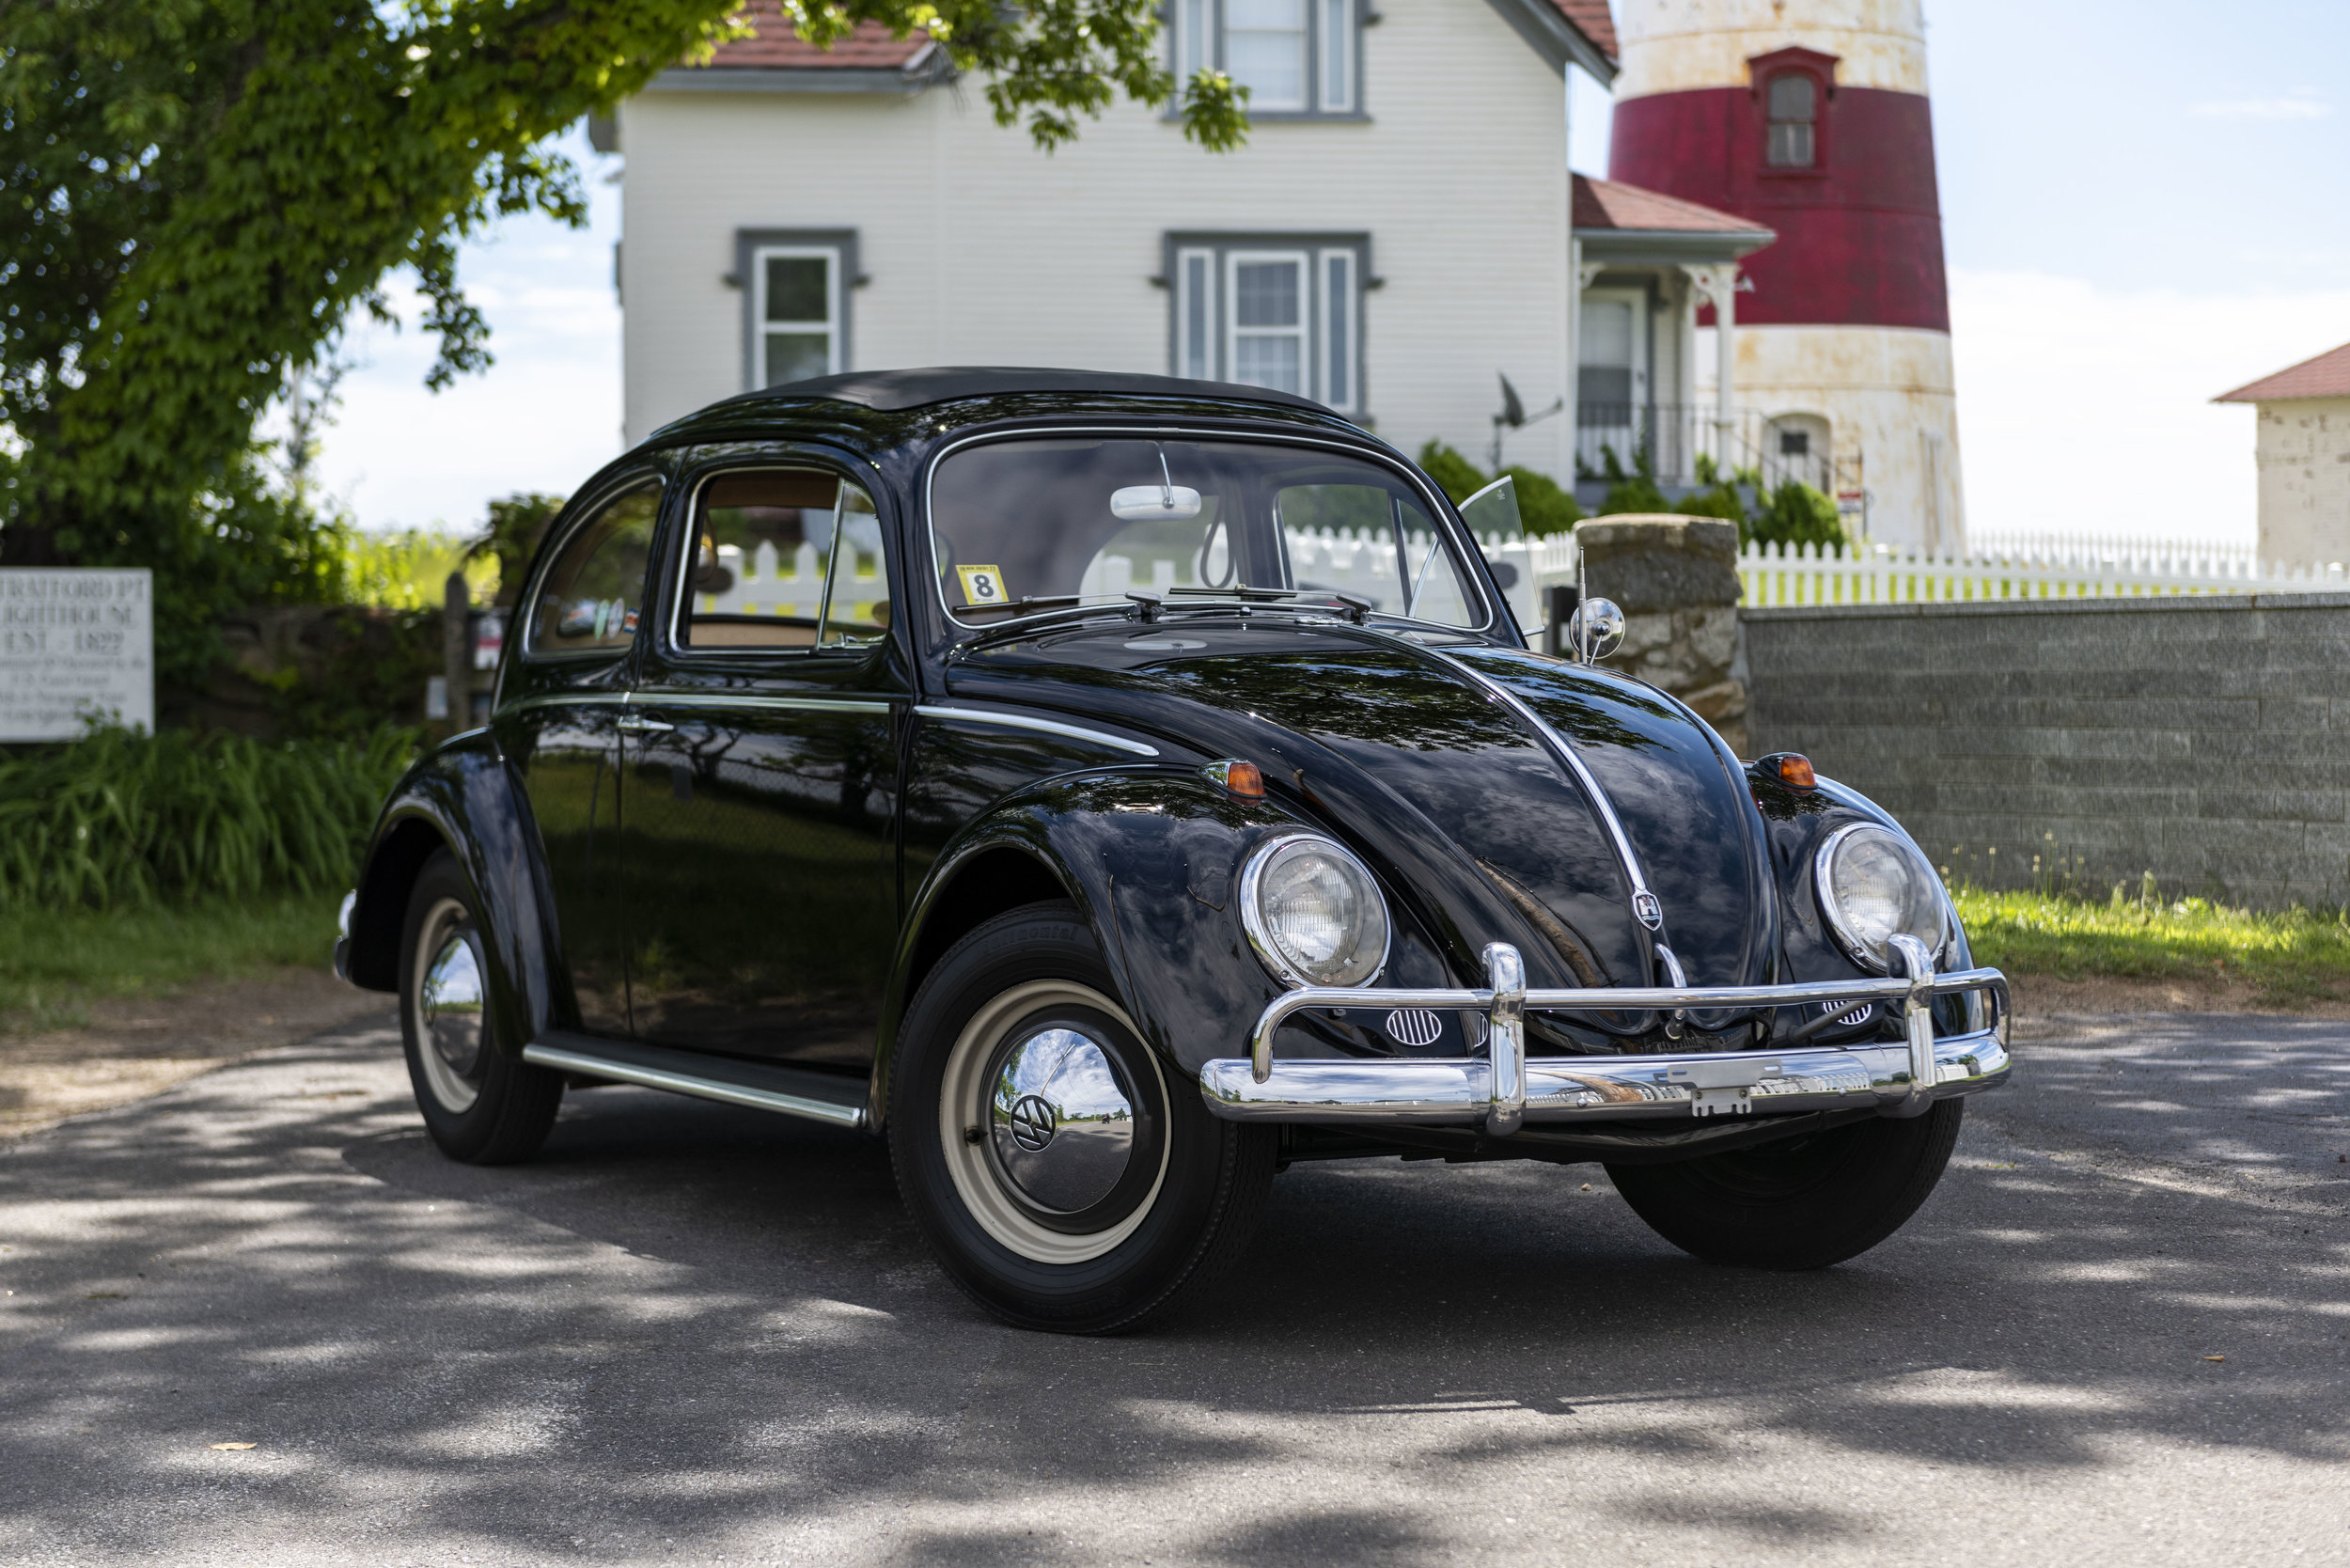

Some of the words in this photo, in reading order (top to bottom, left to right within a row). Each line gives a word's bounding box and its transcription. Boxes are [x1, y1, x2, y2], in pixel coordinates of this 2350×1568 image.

[974, 574, 995, 598] 8
[74, 629, 124, 654] 1822
[1010, 1095, 1056, 1152] VW
